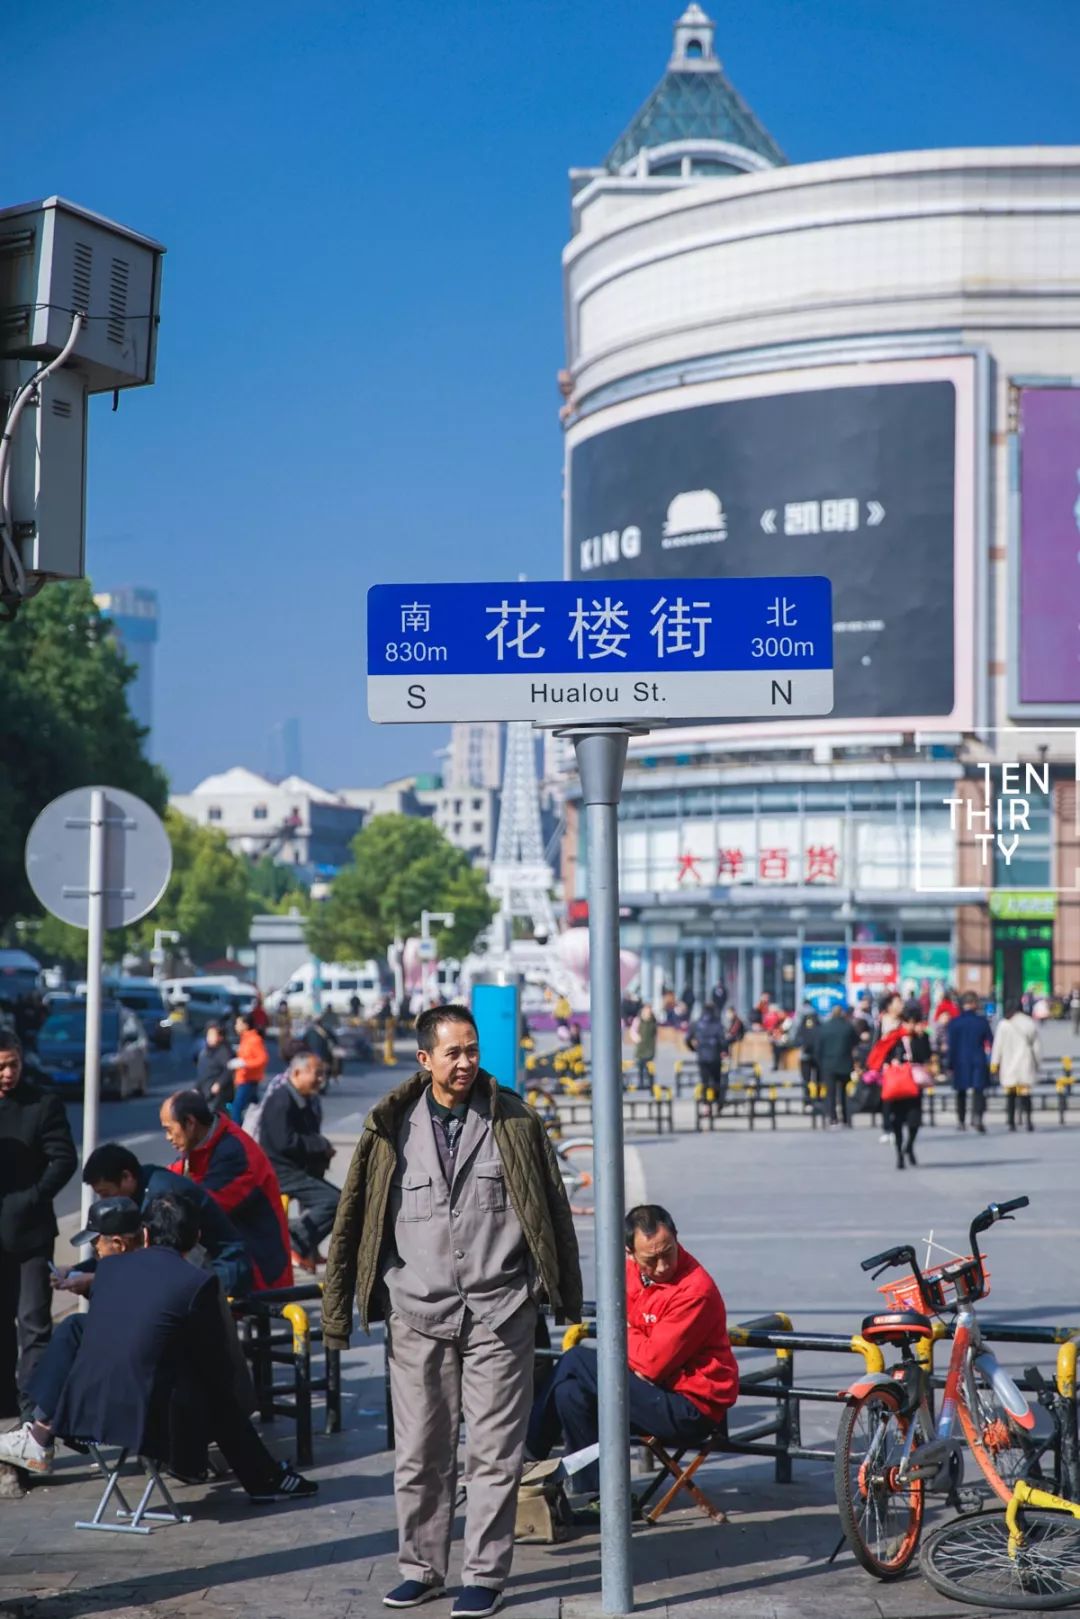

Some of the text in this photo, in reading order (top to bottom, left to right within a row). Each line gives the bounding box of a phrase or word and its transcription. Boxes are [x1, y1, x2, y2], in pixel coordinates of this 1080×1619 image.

[580, 525, 642, 572] KING
[400, 601, 431, 633] 南
[766, 597, 798, 627] 北
[485, 596, 712, 661] 花楼街
[385, 641, 447, 662] 830m
[751, 637, 814, 658] 300m
[407, 684, 427, 710] S
[531, 681, 666, 703] Hualou St.
[771, 679, 792, 705] N
[677, 845, 839, 882] 大洋百货
